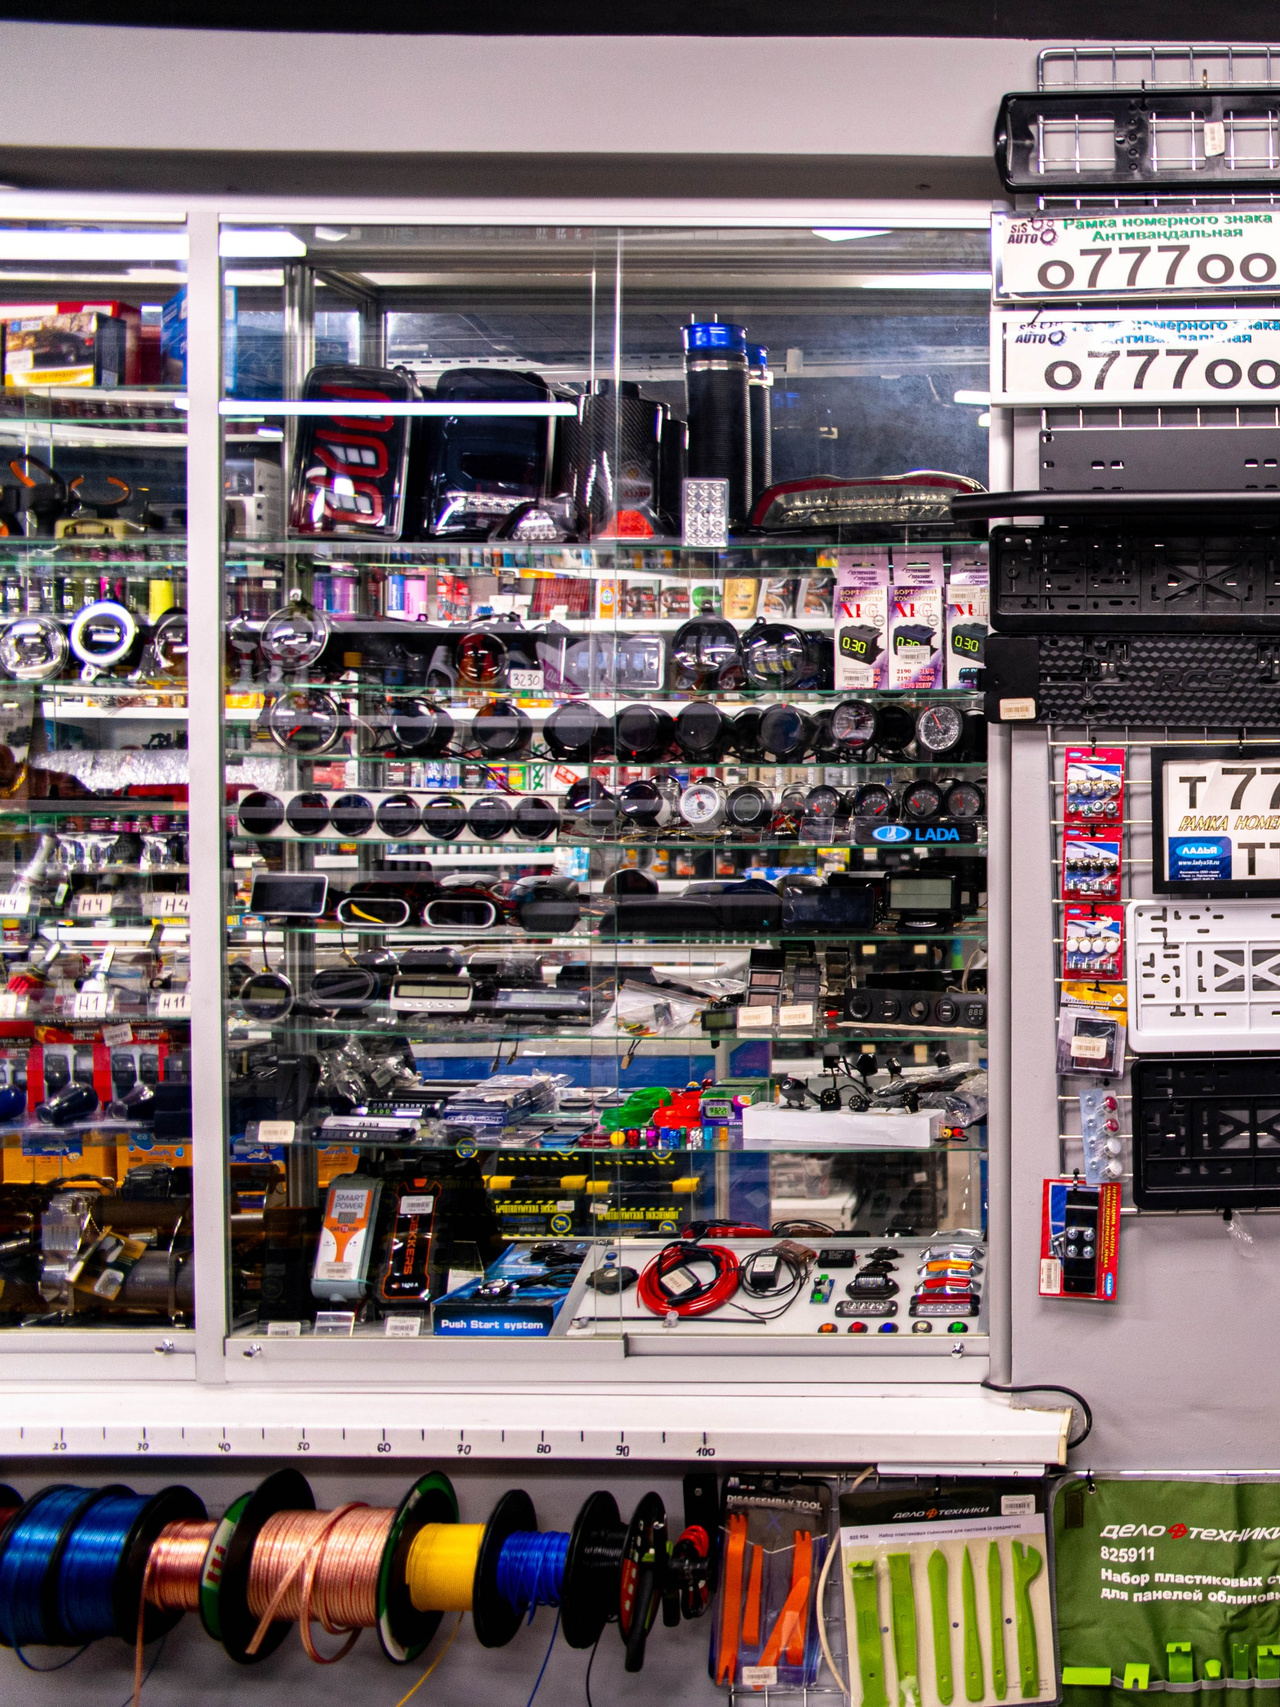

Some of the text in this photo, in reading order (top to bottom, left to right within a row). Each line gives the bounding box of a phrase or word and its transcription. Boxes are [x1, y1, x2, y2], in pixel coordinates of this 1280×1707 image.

[1063, 213, 1273, 230] Рамка номерного знака
[1007, 234, 1038, 244] AUTO
[1092, 228, 1243, 242] Антивандальная
[1015, 334, 1047, 344] AUTO
[842, 637, 866, 654] 0.30
[955, 635, 978, 652] 0.30
[513, 672, 540, 686] 3230
[1154, 669, 1235, 692] RCS
[1178, 815, 1229, 831] РАМКА
[915, 827, 960, 841] LADA
[1182, 846, 1218, 855] ЛАДЬЯ
[83, 899, 103, 913] H4
[165, 898, 188, 913] H4
[80, 995, 98, 1011] H1
[164, 994, 185, 1009] H11
[336, 1194, 365, 1202] SMART
[334, 1202, 364, 1210] POWER
[441, 1319, 543, 1333] Push Start system
[51, 1440, 715, 1457] 20 30 40 50 60 70 80 90 100
[797, 1500, 823, 1511] TOOL
[1100, 1546, 1155, 1562] 825911
[1101, 1568, 1150, 1586] Набор
[1154, 1571, 1263, 1588] пластиковых
[1101, 1586, 1128, 1601] для
[1133, 1587, 1203, 1602] панелей
